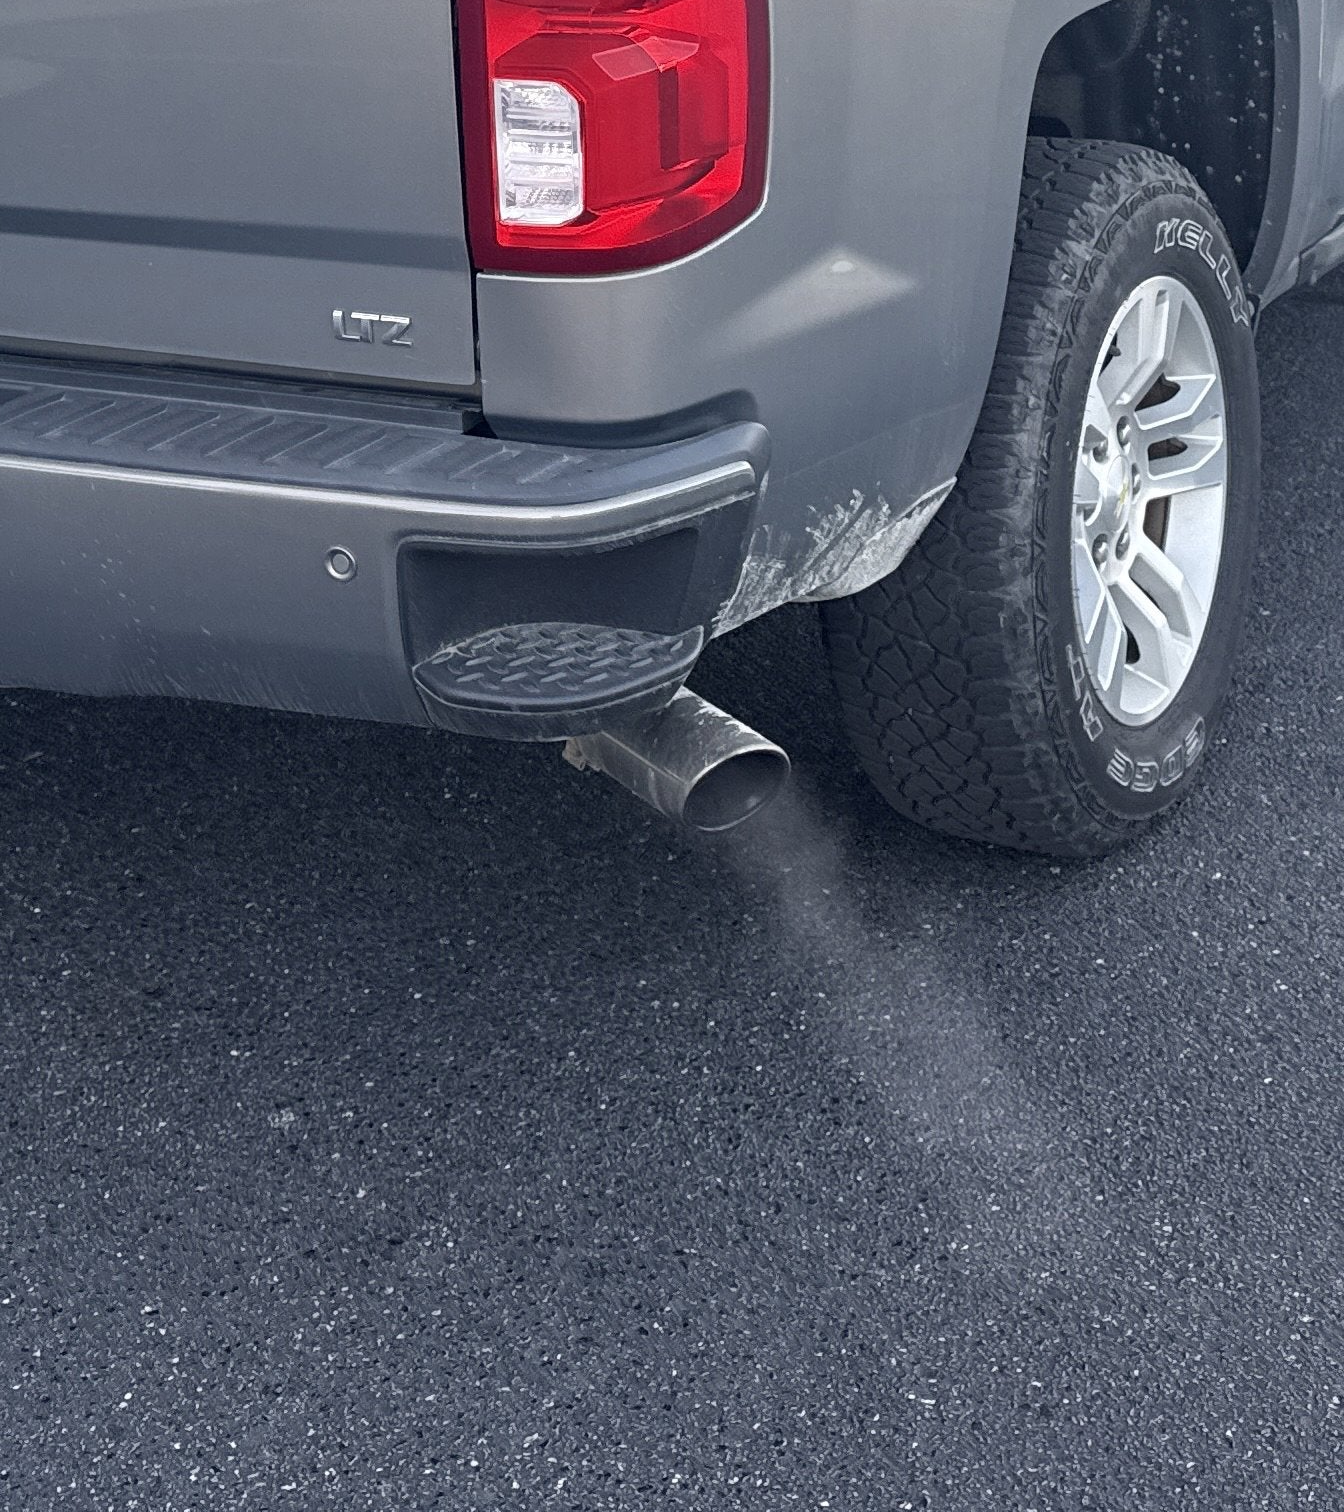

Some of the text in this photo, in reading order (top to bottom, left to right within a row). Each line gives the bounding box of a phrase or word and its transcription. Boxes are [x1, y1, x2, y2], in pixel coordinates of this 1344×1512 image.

[1153, 217, 1249, 327] KELLY
[332, 309, 414, 348] LTZ
[1107, 715, 1206, 793] EDGE
